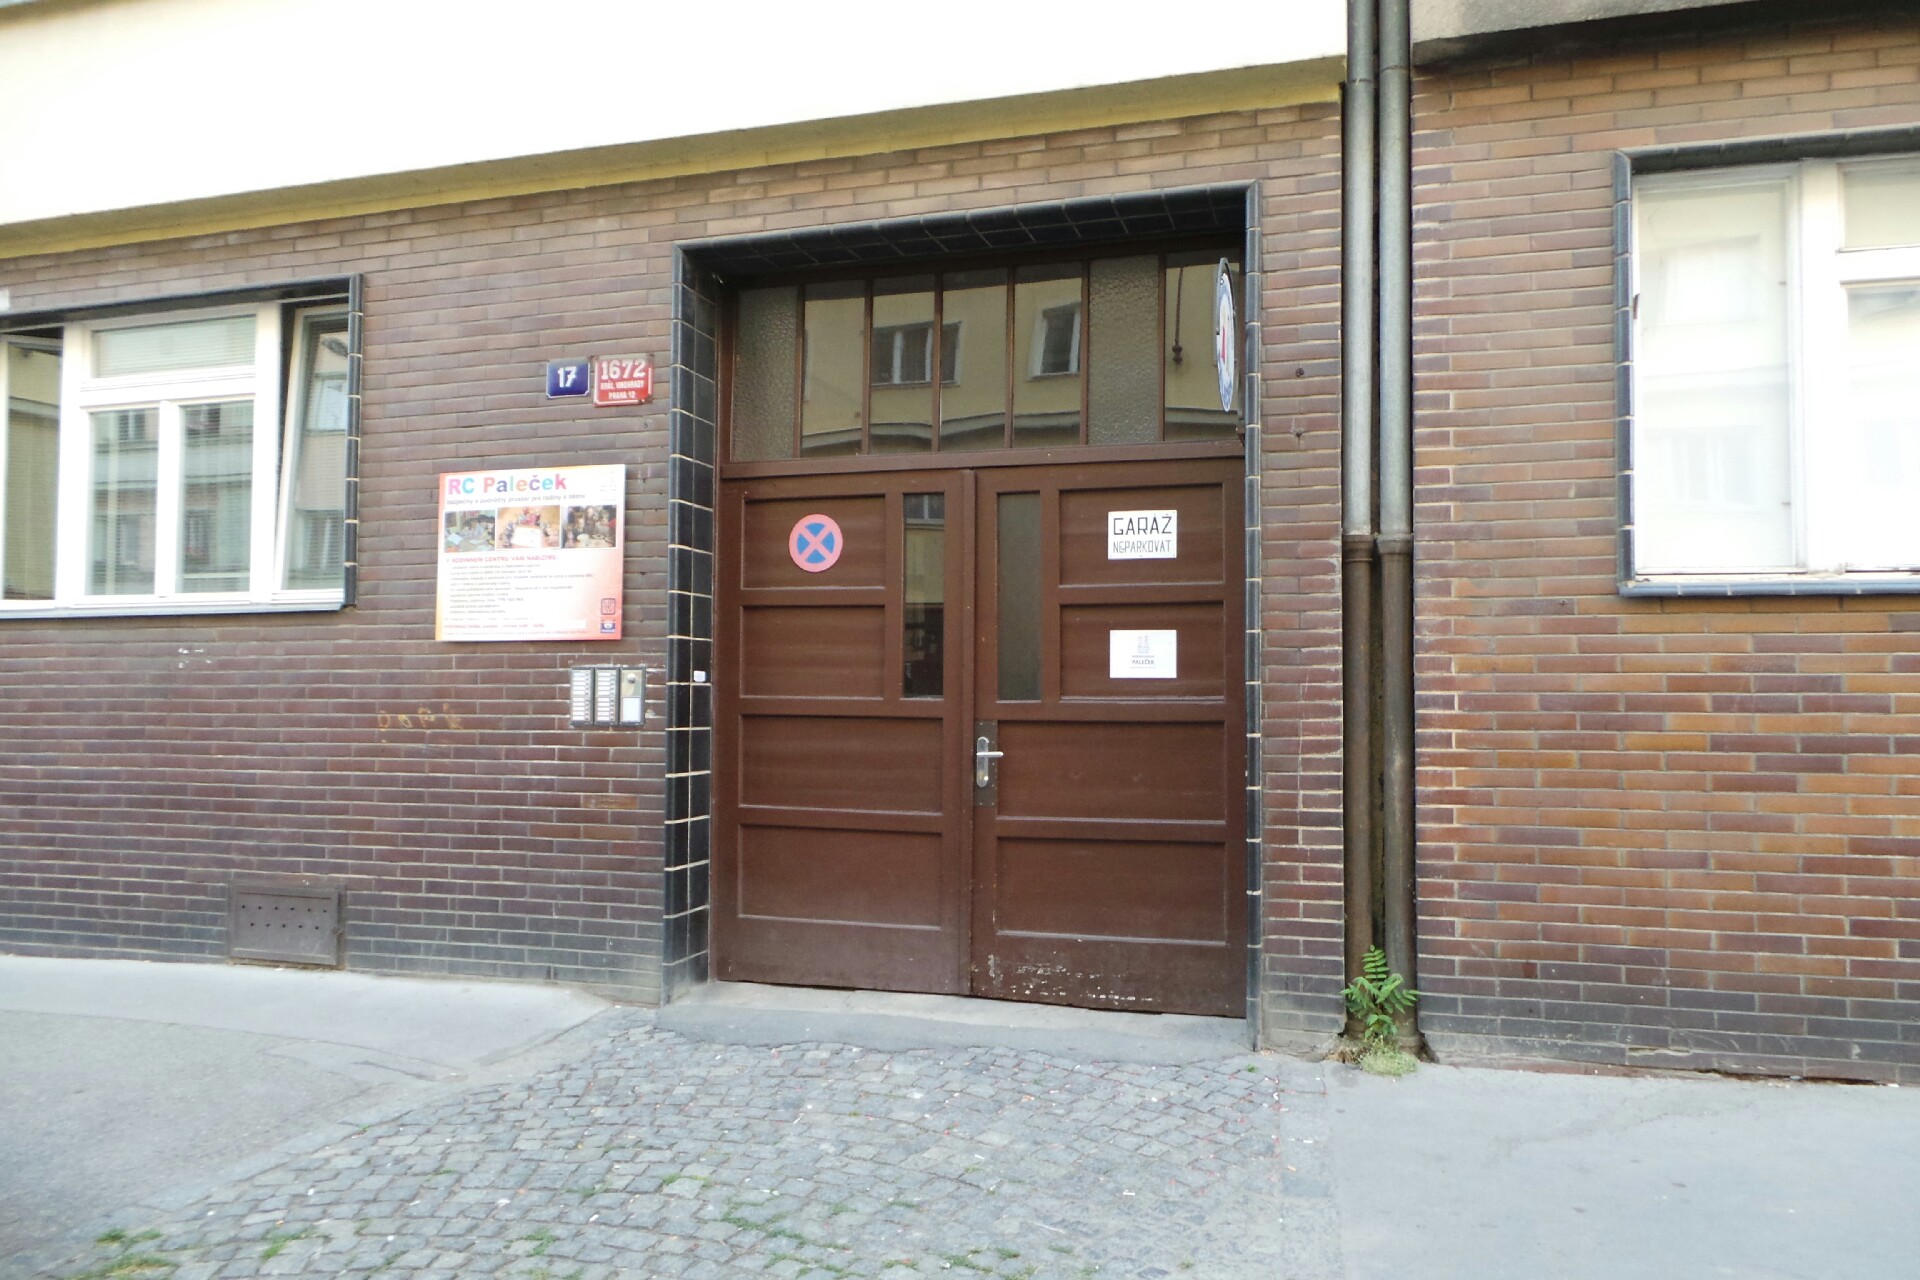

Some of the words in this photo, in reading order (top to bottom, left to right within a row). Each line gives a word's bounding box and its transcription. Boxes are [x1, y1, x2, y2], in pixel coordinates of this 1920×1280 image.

[558, 366, 577, 388] 17
[601, 359, 646, 380] 1672
[608, 391, 628, 400] PRAHA
[628, 390, 636, 399] 12
[448, 477, 475, 495] RC
[483, 473, 567, 494] Paleček
[1113, 540, 1171, 553] NEPARKOVAT
